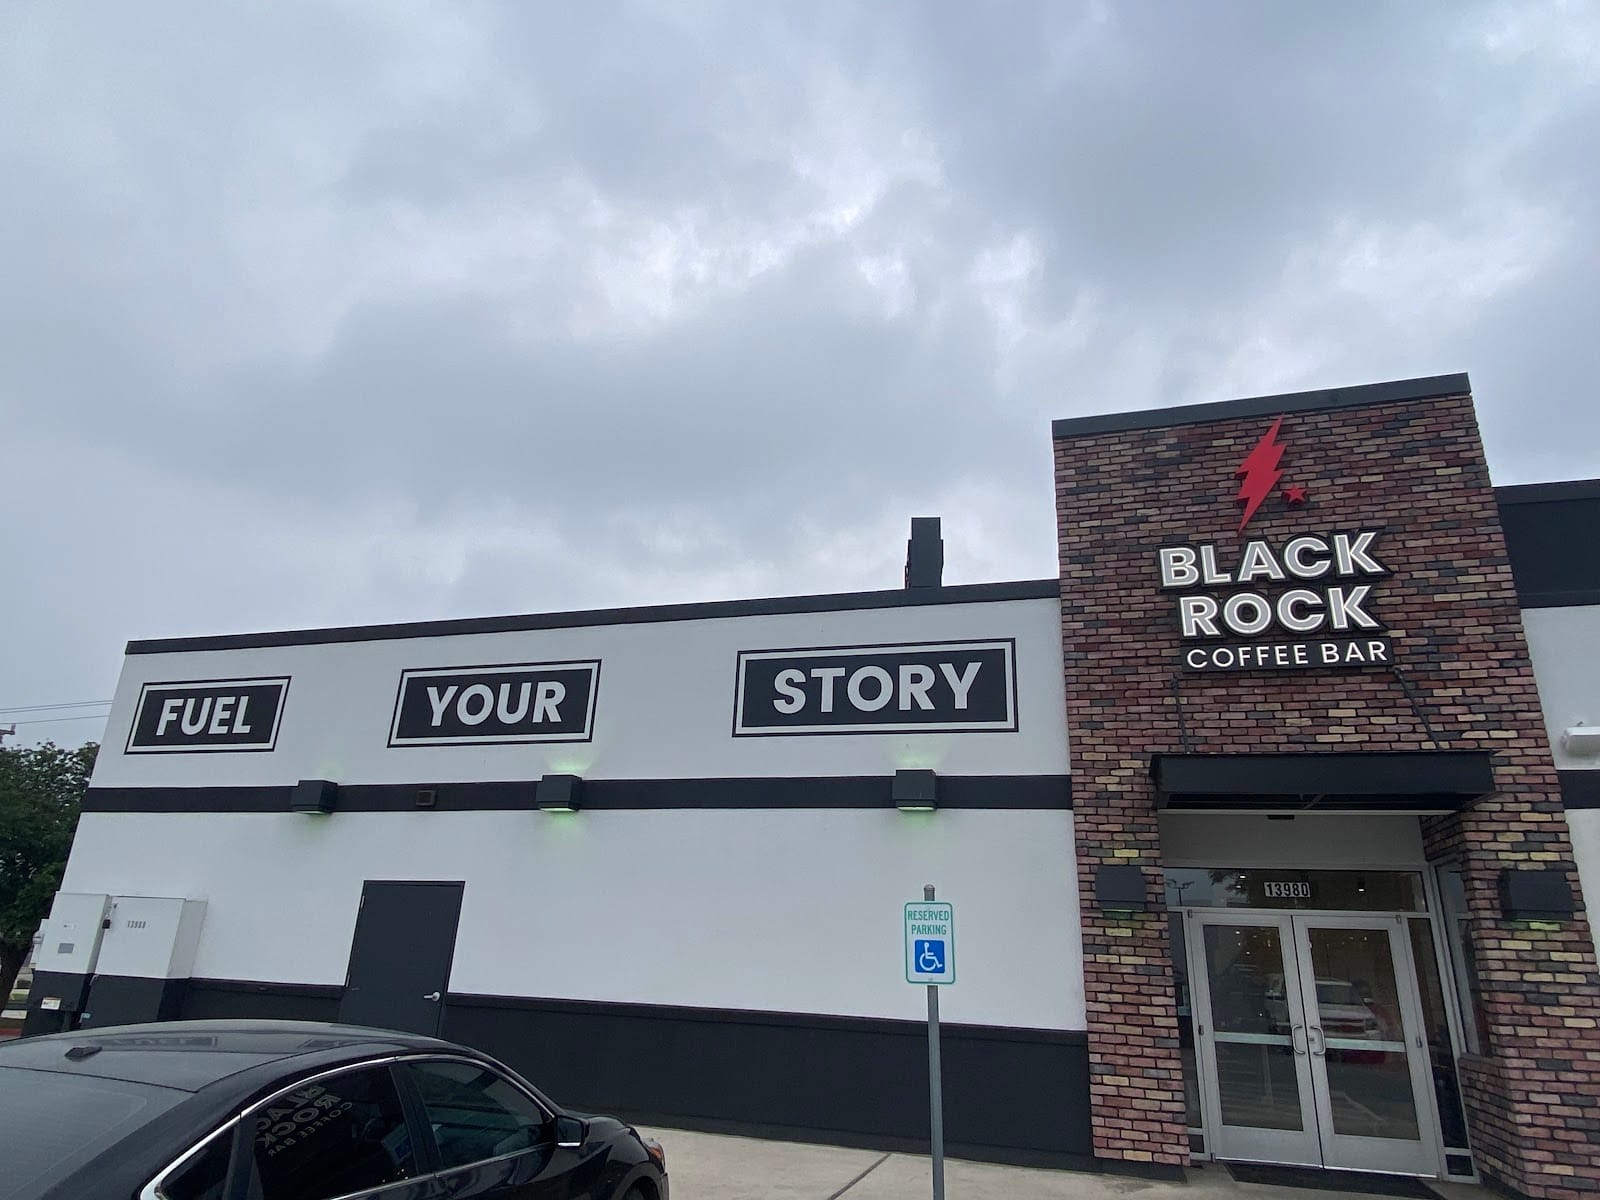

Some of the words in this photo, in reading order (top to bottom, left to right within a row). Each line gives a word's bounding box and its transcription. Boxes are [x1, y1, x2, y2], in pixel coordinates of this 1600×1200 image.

[1159, 531, 1385, 587] BLACK
[1179, 585, 1381, 637] ROCK
[1187, 644, 1309, 668] COFFEE
[1321, 641, 1388, 663] BAR
[155, 695, 252, 737] FUEL
[426, 681, 566, 727] YOUR
[772, 661, 983, 714] STORY
[1265, 882, 1310, 897] 13980
[907, 910, 950, 921] RESERVED
[911, 924, 947, 935] PARKING
